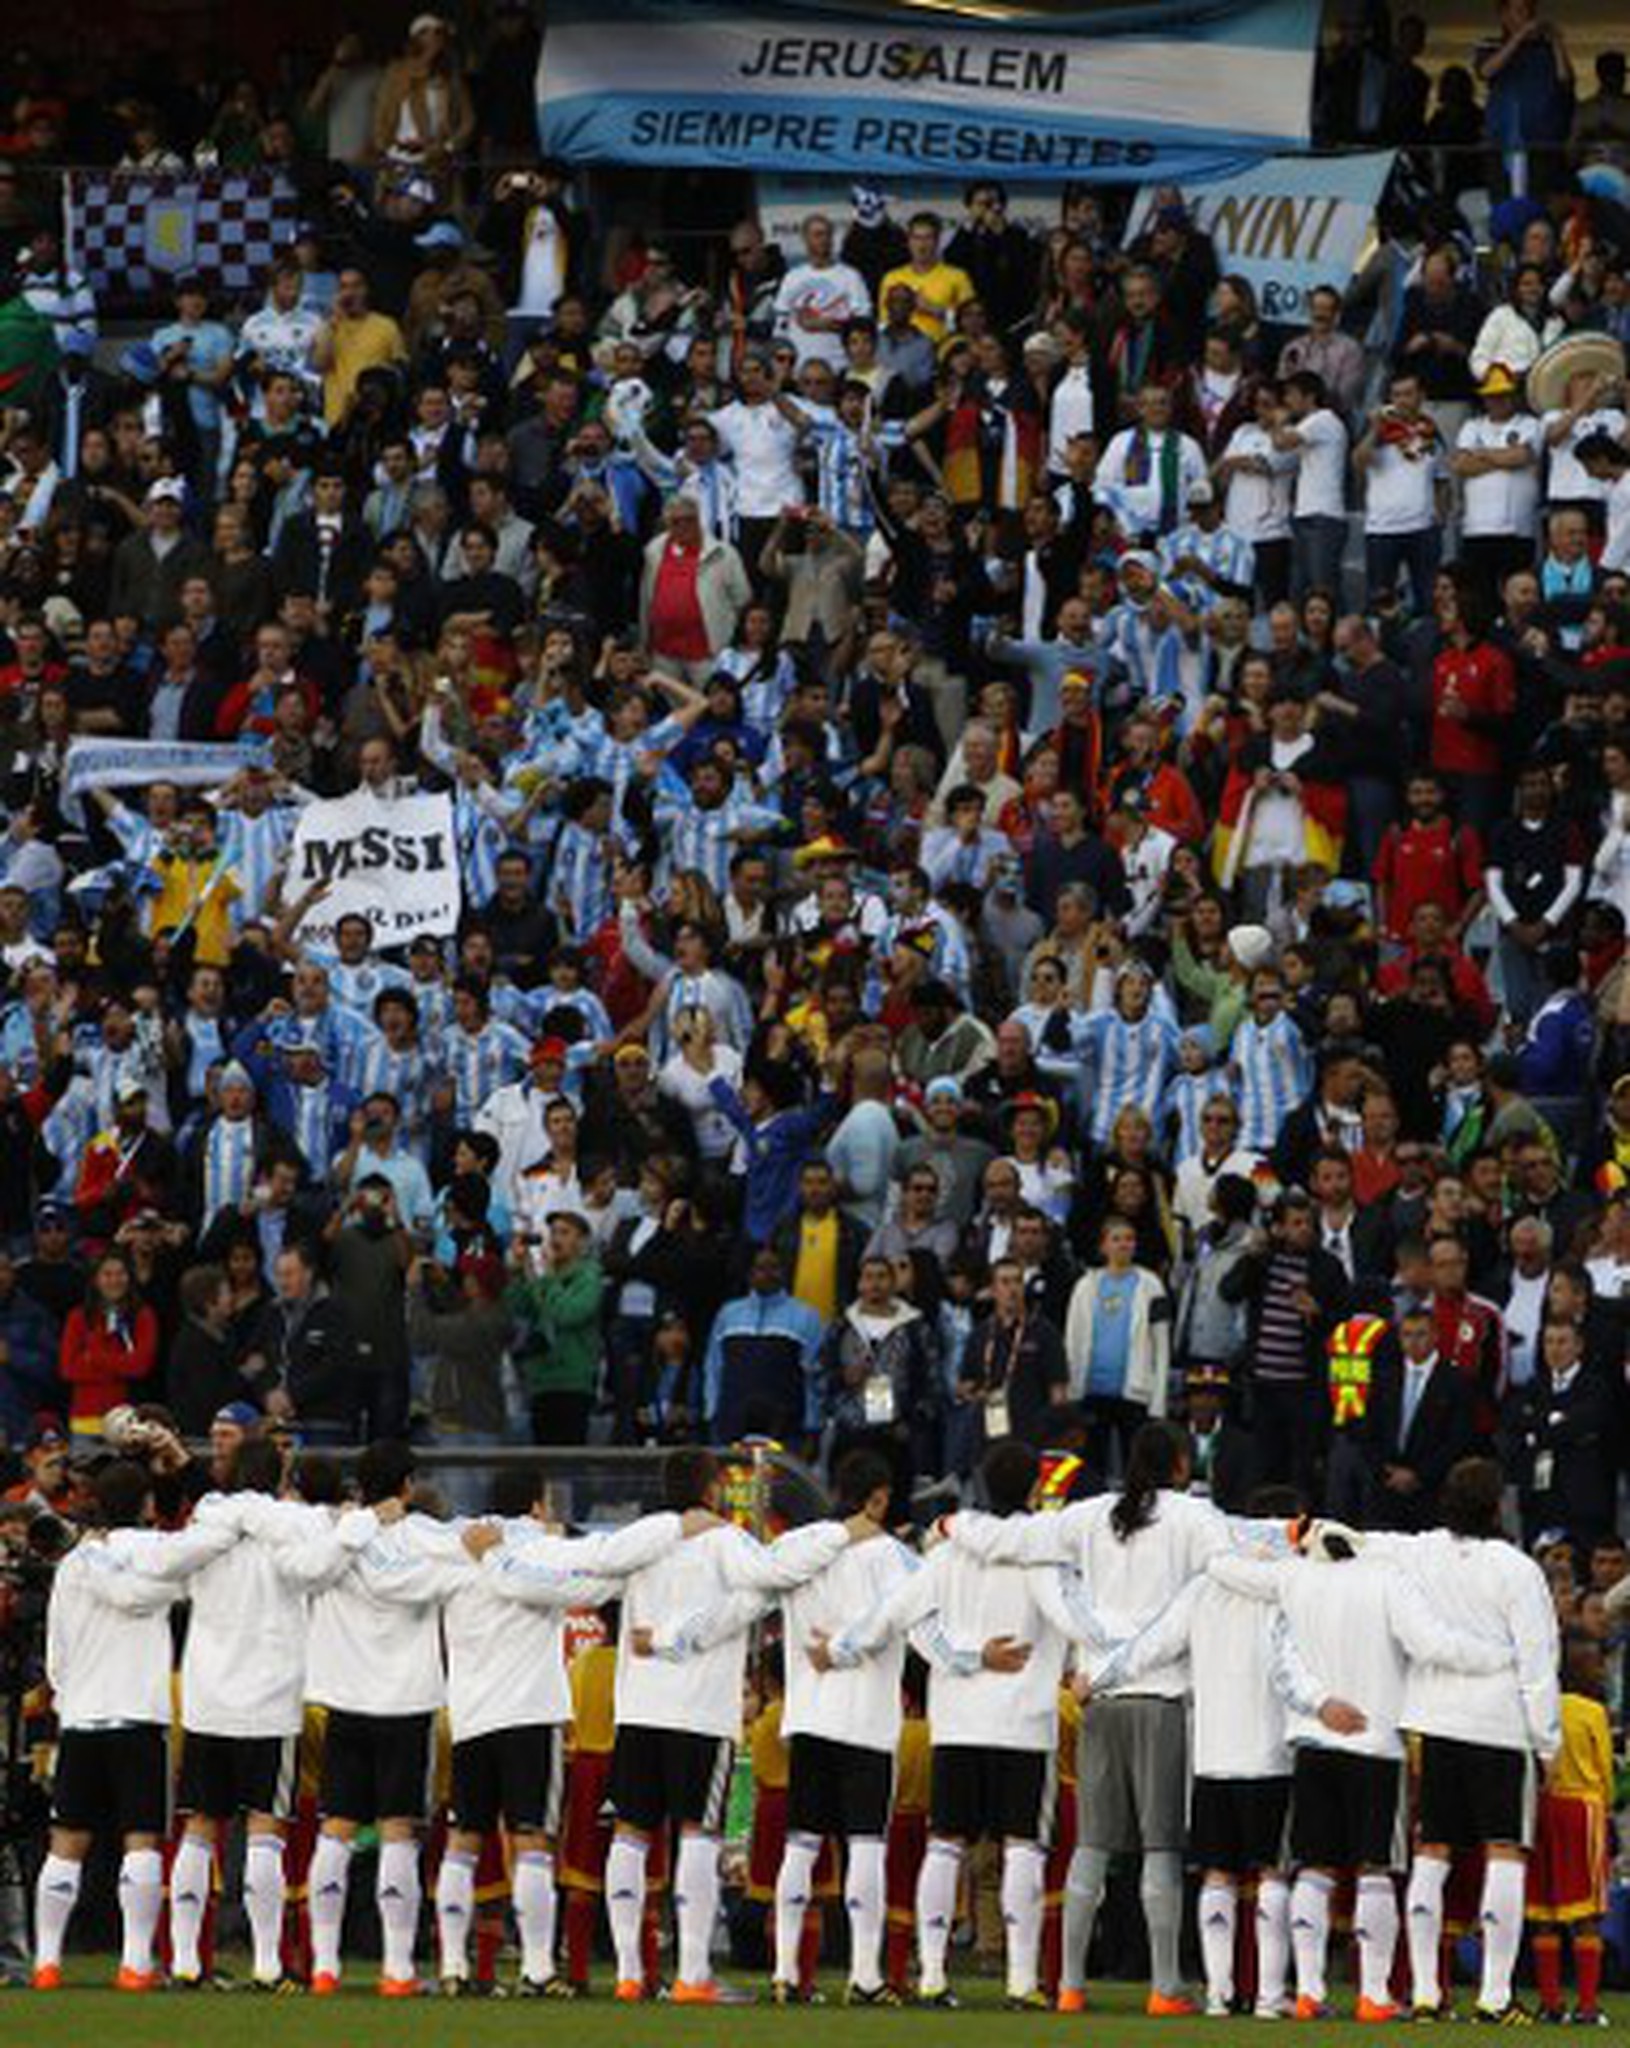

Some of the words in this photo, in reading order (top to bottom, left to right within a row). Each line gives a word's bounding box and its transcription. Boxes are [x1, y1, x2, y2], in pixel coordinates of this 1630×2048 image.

[741, 39, 1066, 92] JERUSALEM
[631, 111, 837, 152] SIEMPRE
[853, 118, 1156, 166] PRESENTES
